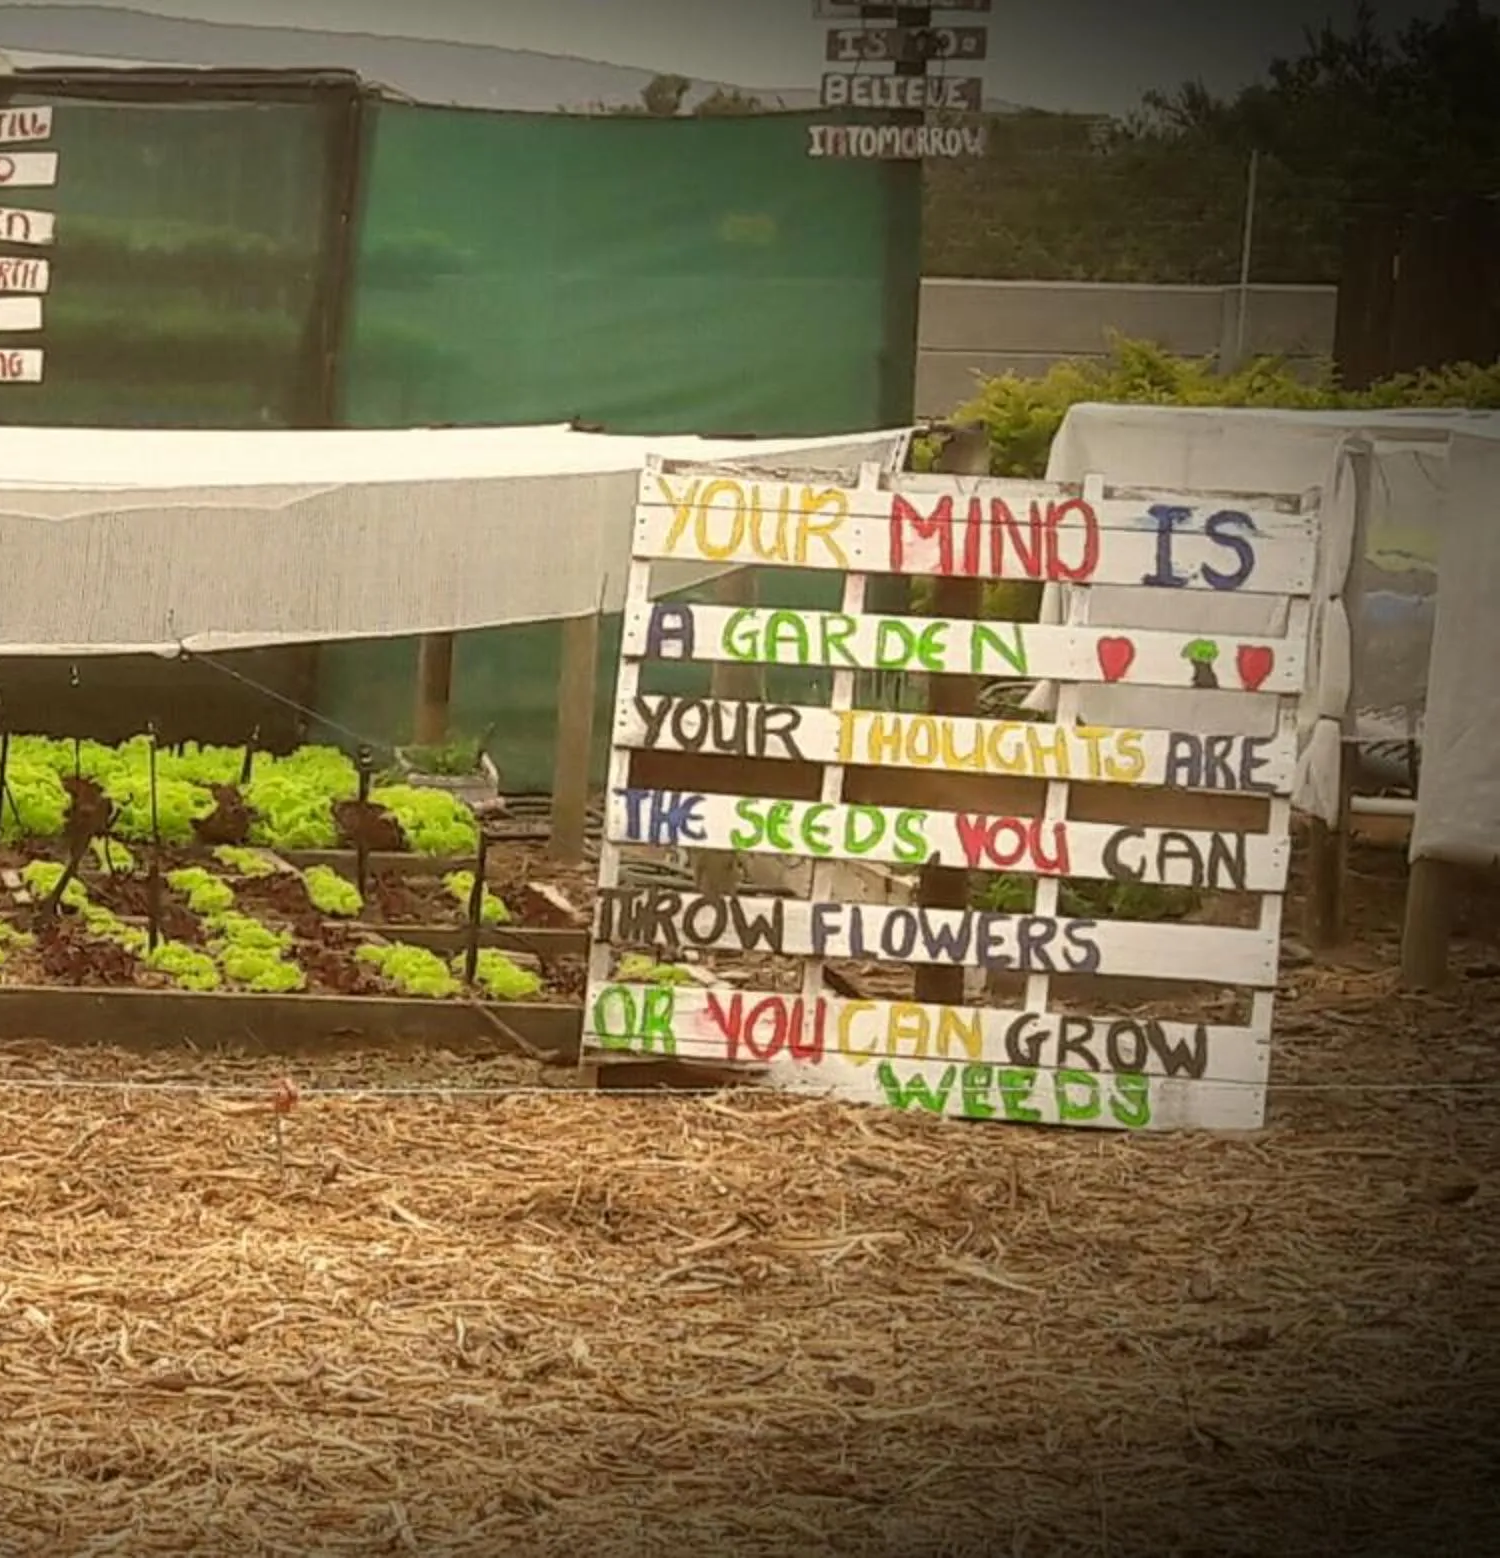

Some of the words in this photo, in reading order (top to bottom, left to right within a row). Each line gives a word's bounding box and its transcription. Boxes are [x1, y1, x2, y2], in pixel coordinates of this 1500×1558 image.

[837, 30, 887, 60] IS
[825, 75, 969, 109] BELIEVE
[655, 476, 850, 571] YOUR
[889, 493, 1100, 582] MIND
[1142, 503, 1257, 591] IS
[645, 601, 695, 661] A
[721, 607, 1028, 676] GARDEN
[633, 696, 804, 759] YOUR
[831, 708, 1145, 783] THOUGHTS
[1164, 731, 1279, 791] ARE
[613, 787, 708, 847] THE
[728, 797, 928, 866] SEEDS
[955, 813, 1070, 876] YOU
[1102, 827, 1246, 890] CAN
[597, 887, 785, 956] THROW
[810, 902, 1100, 974] FLOWERS
[593, 985, 678, 1054] OR
[704, 992, 828, 1065] YOU
[837, 1000, 984, 1066] CAN
[1005, 1012, 1208, 1079] GROW
[877, 1060, 1151, 1129] WEEDS
